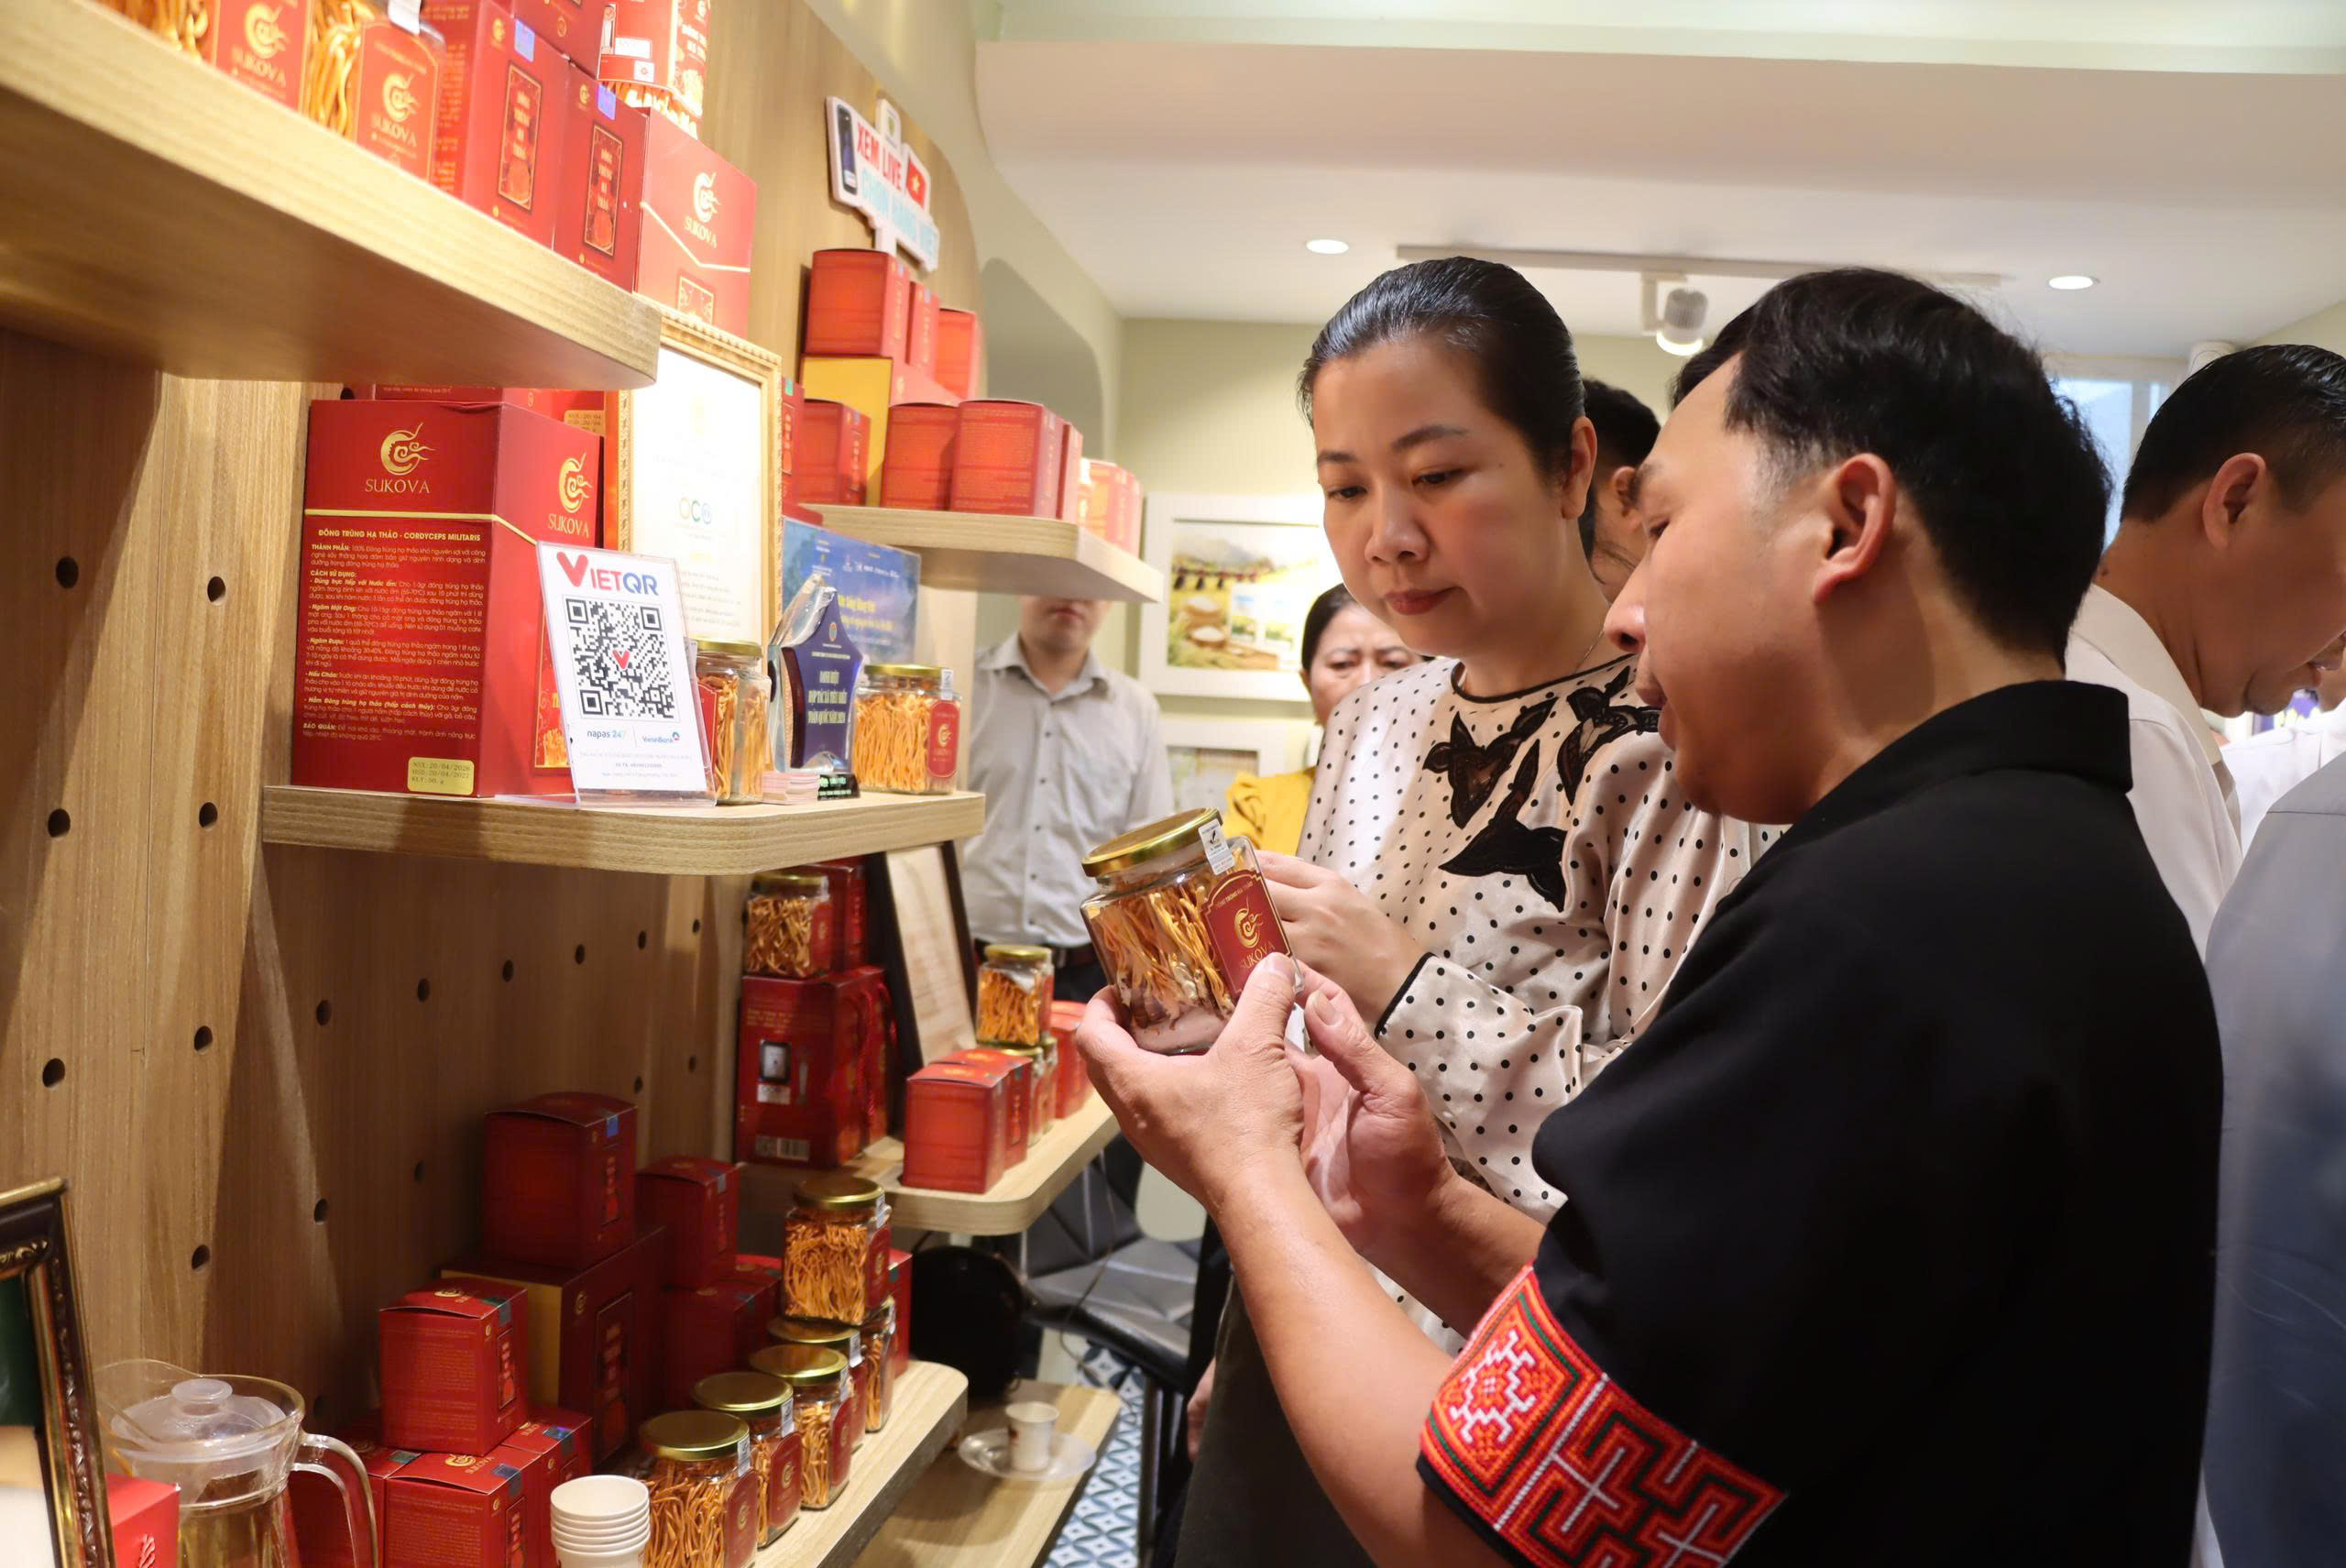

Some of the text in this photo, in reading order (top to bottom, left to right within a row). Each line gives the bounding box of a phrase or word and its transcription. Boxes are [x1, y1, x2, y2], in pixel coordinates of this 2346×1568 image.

[857, 123, 903, 191] XEM LIVE
[685, 216, 717, 248] SUKOVA
[365, 478, 430, 494] SUKOVA
[342, 528, 366, 537] TRÙNG
[367, 531, 377, 540] HẠ
[378, 530, 398, 538] THẢO
[403, 532, 446, 540] CORDYCEPS
[549, 513, 589, 539] SUKOVA
[556, 551, 659, 596] VIETQR
[587, 729, 609, 739] napas
